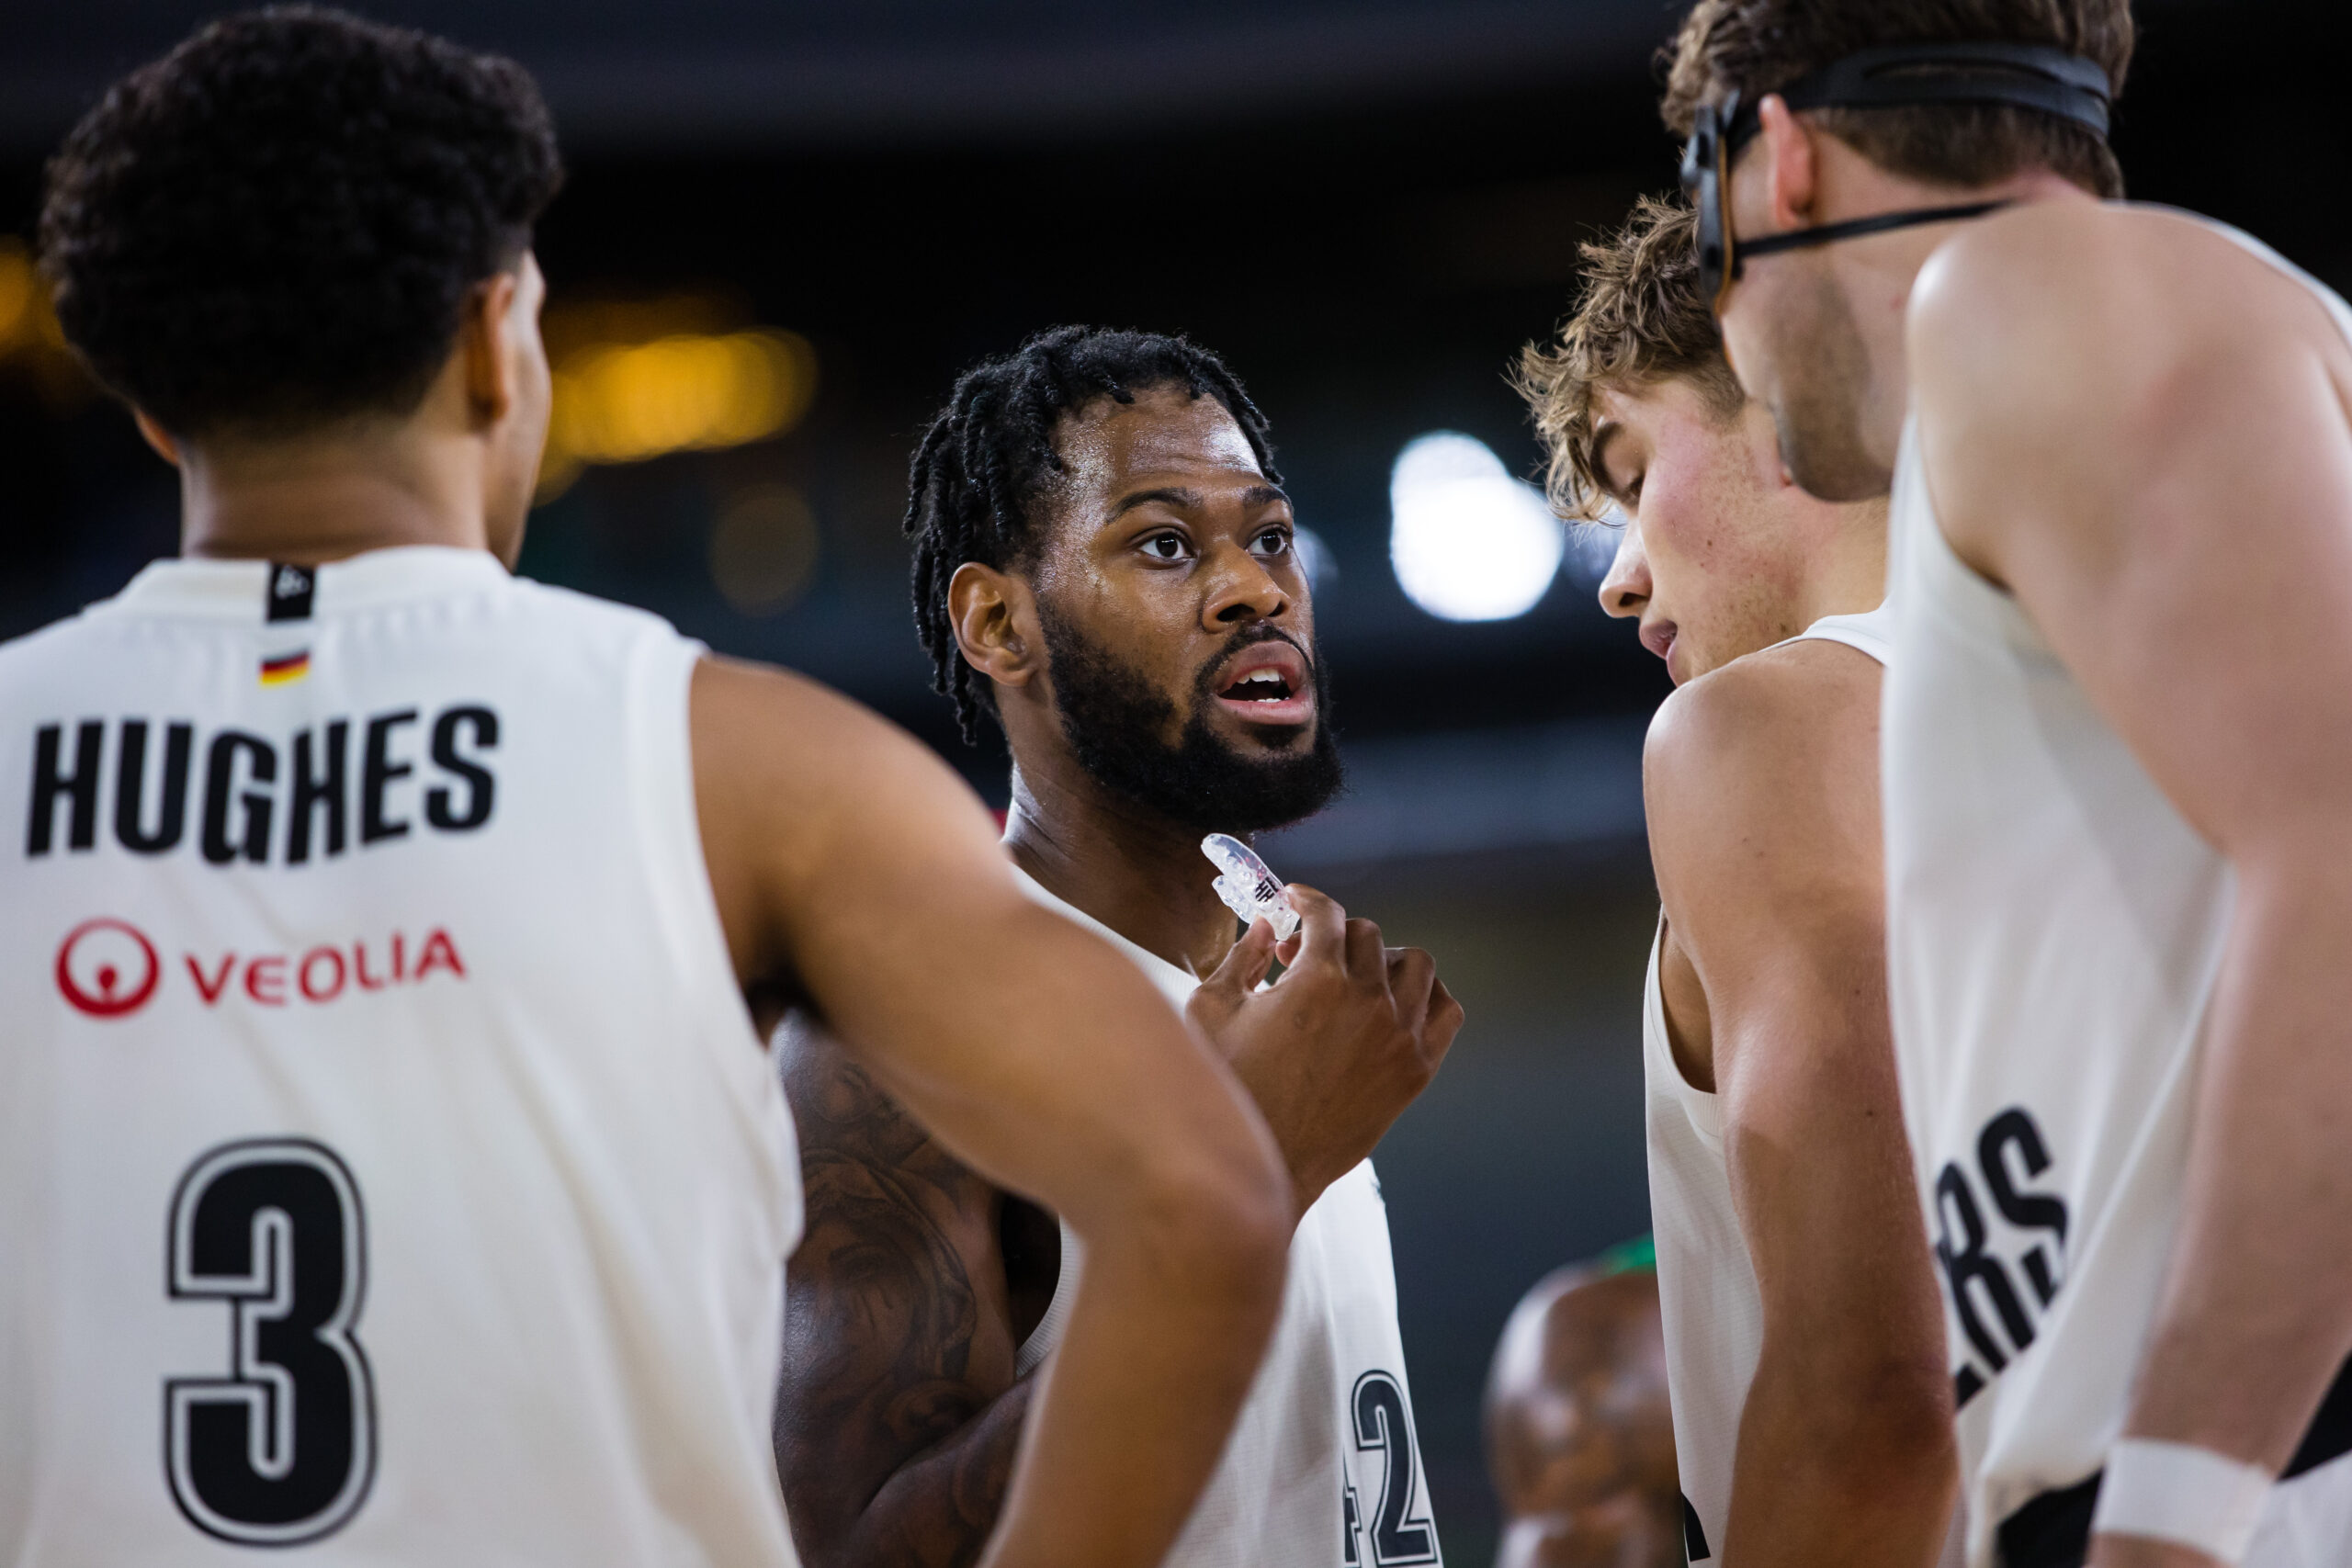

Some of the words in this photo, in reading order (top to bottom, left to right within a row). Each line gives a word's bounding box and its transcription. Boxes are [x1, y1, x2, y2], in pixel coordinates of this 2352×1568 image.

[26, 704, 502, 866] HUGHES
[185, 927, 468, 1007] VEOLIA
[164, 1135, 379, 1549] 3
[1935, 1108, 2069, 1412] RS
